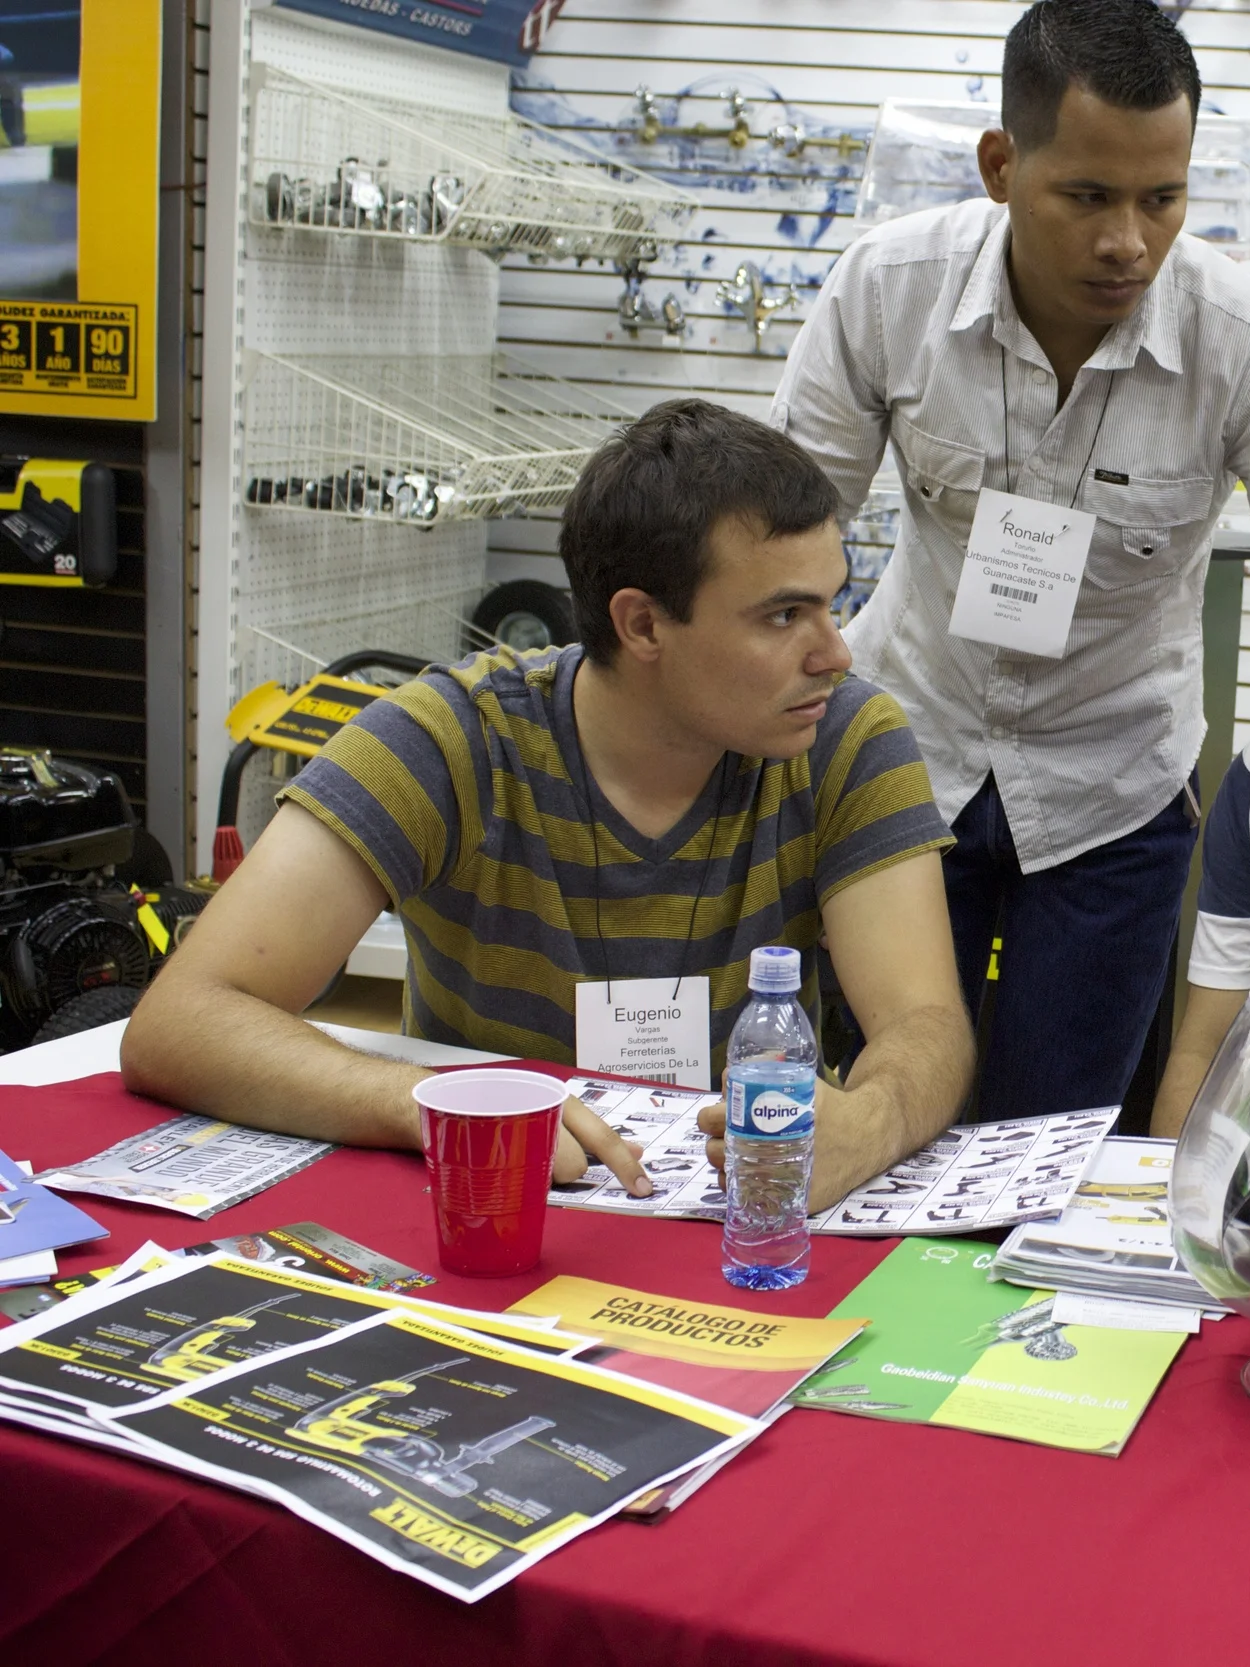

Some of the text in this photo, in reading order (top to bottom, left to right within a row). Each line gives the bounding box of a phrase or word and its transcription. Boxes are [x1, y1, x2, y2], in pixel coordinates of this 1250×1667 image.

[410, 8, 472, 36] CASTORS
[0, 323, 20, 350] 3
[49, 326, 65, 353] 1
[90, 328, 124, 356] 90
[45, 353, 72, 371] AÑO
[91, 356, 122, 374] DÍAS
[1003, 521, 1054, 545] Ronald
[54, 553, 77, 570] 20
[965, 549, 1077, 584] Urbanismos Tecnicos De
[1001, 547, 1043, 563] Administrador
[982, 566, 1055, 591] Guanacaste S.a
[614, 1005, 682, 1025] Eugenio
[627, 1036, 669, 1045] Subgerente
[635, 1026, 661, 1035] Vargas
[597, 1058, 699, 1074] Agroservicios De La
[753, 1103, 800, 1121] alpina
[154, 1146, 239, 1178] MUNDO
[182, 1150, 276, 1188] GRANDE
[589, 1308, 770, 1349] PRODUCTOS
[606, 1296, 787, 1337] CATÁLOGO DE
[880, 1363, 955, 1384] Gaobeidian
[957, 1374, 1016, 1393] Sanyuan
[296, 1454, 382, 1498] ROTOMARTILLO
